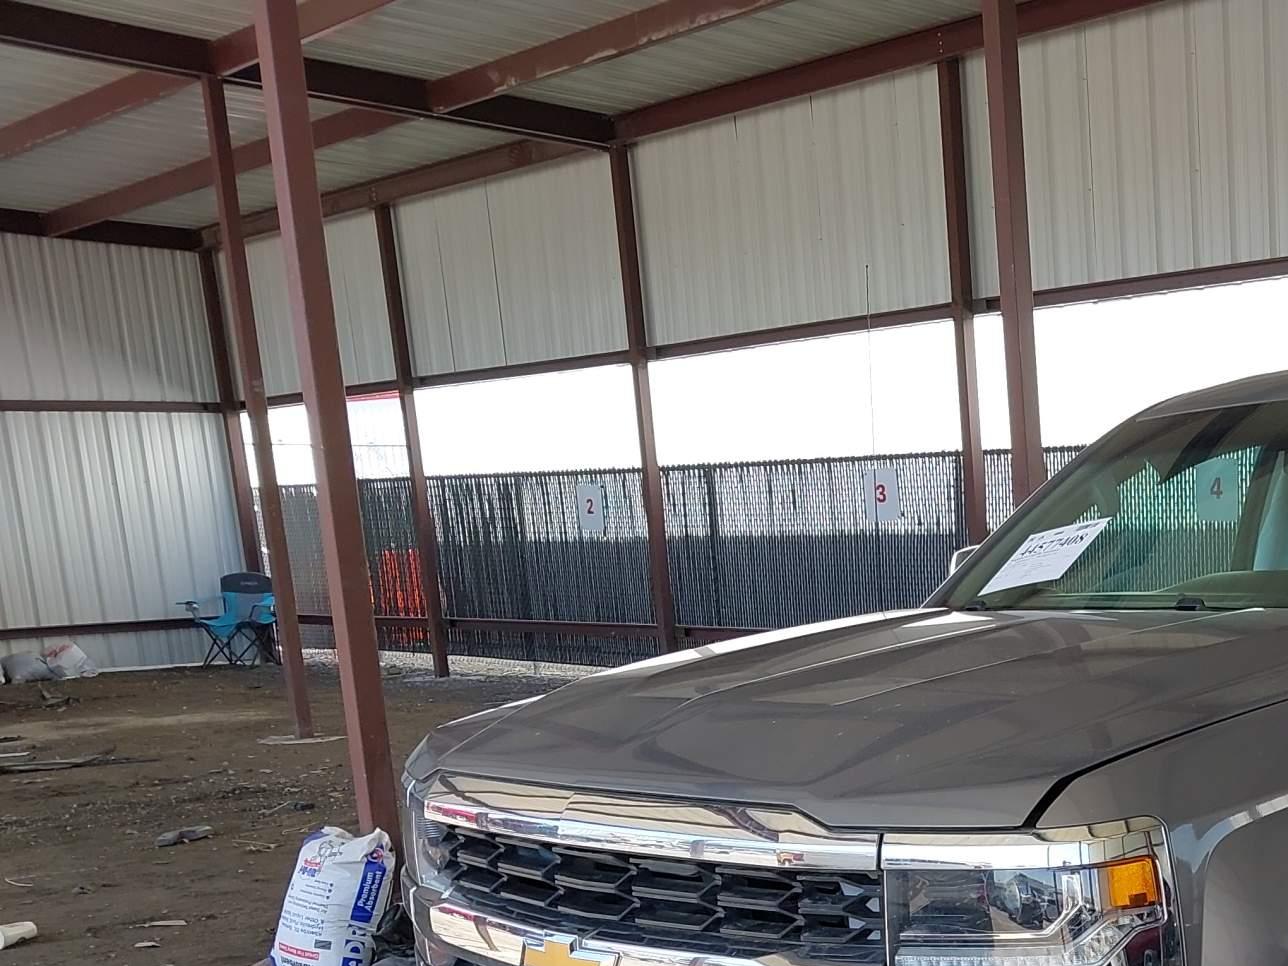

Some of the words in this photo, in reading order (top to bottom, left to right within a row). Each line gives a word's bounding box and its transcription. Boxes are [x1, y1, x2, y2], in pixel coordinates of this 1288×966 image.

[875, 484, 887, 503] 3
[1210, 477, 1223, 499] 4
[586, 498, 595, 515] 2
[357, 872, 374, 907] Premium
[364, 871, 383, 913] Absorbent
